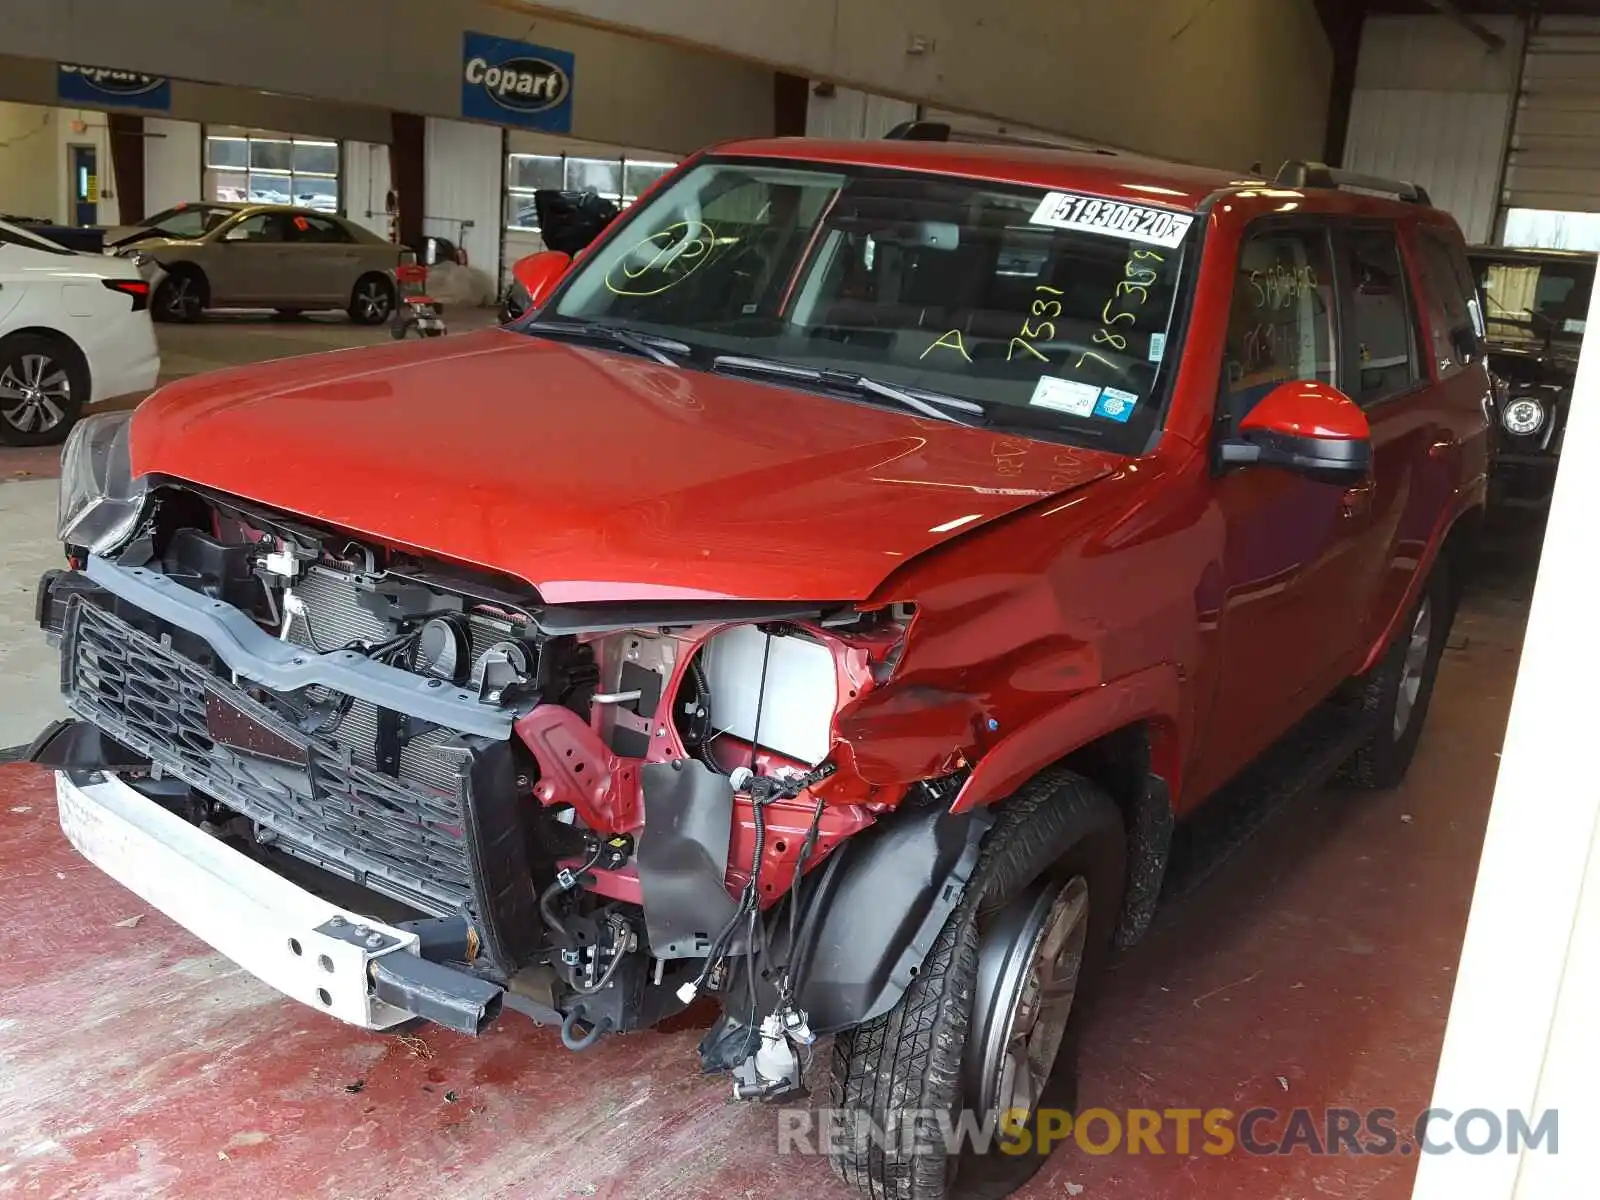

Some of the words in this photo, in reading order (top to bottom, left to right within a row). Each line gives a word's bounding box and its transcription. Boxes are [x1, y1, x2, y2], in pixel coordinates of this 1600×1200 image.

[465, 58, 558, 97] Copart
[1050, 195, 1174, 238] 51930620
[1006, 286, 1064, 362] 7531
[919, 329, 973, 364] A
